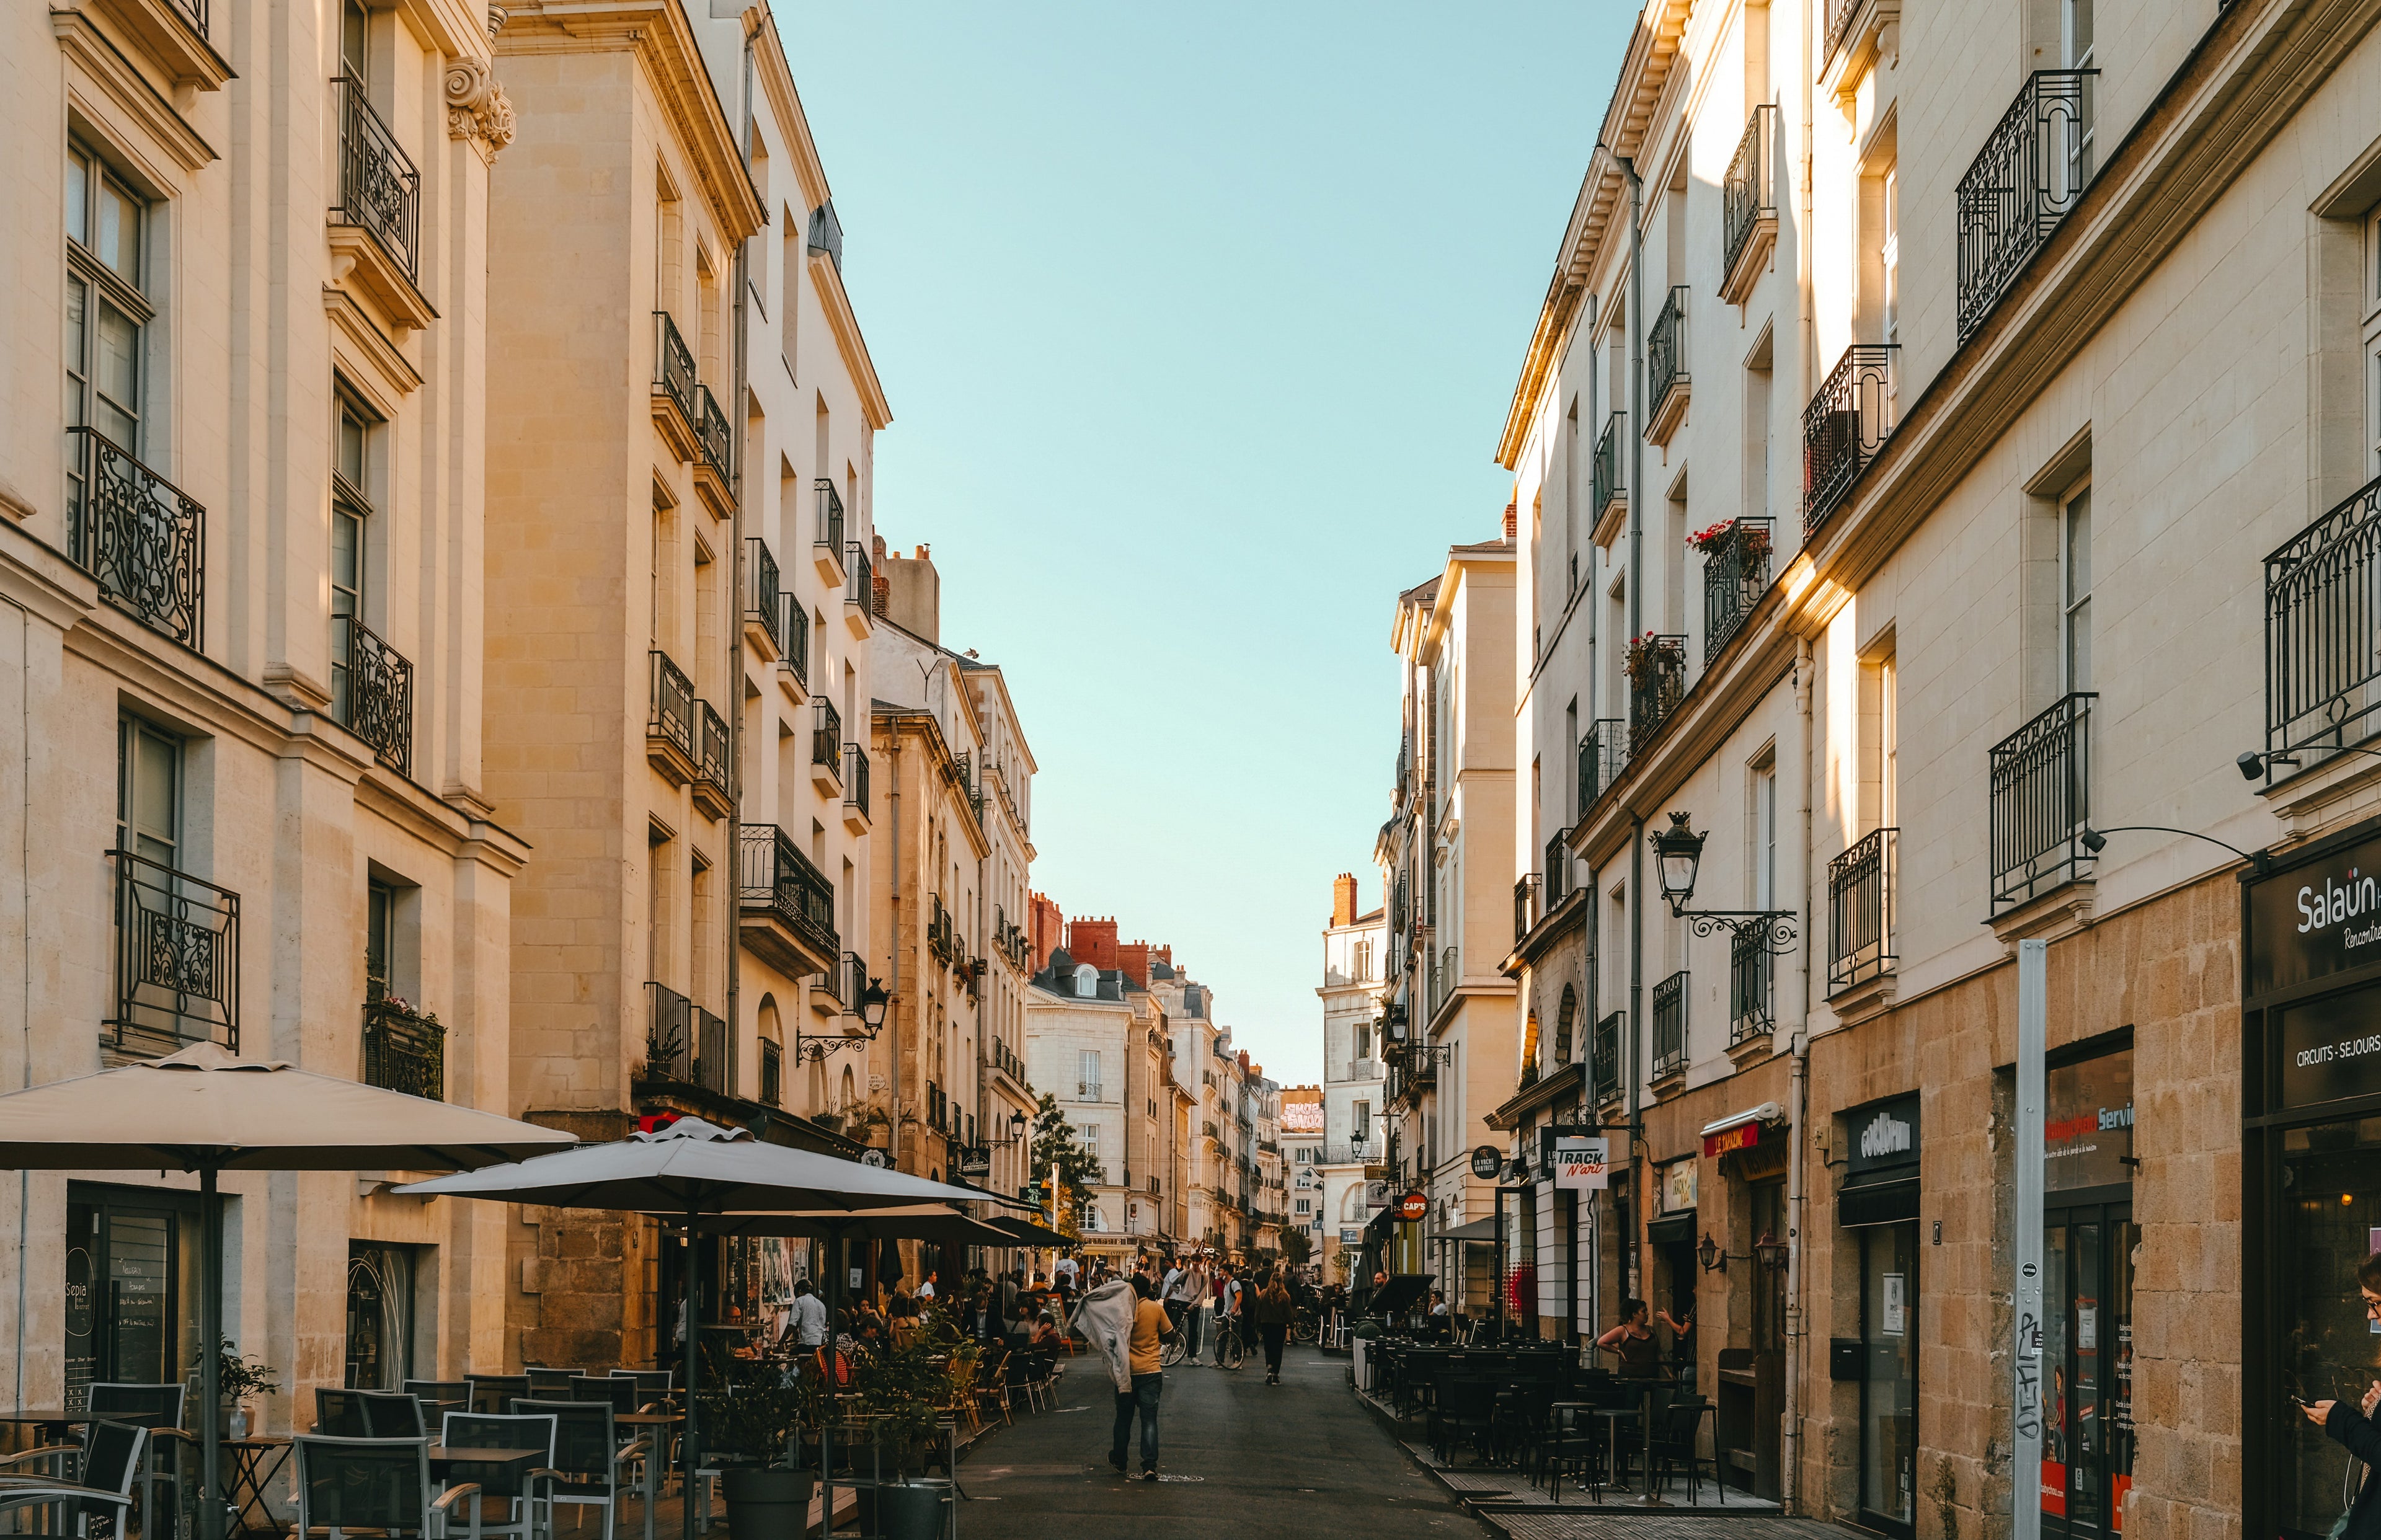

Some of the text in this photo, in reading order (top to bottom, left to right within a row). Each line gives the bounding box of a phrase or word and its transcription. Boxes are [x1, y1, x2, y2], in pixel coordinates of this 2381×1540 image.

[2297, 867, 2375, 933] Salaün
[2297, 1045, 2333, 1067] CIRCUITS
[2339, 1034, 2381, 1058] SEJOURS
[1557, 1149, 1603, 1164] TRACK
[1566, 1162, 1603, 1177] N'art
[1403, 1203, 1425, 1211] CAP'S
